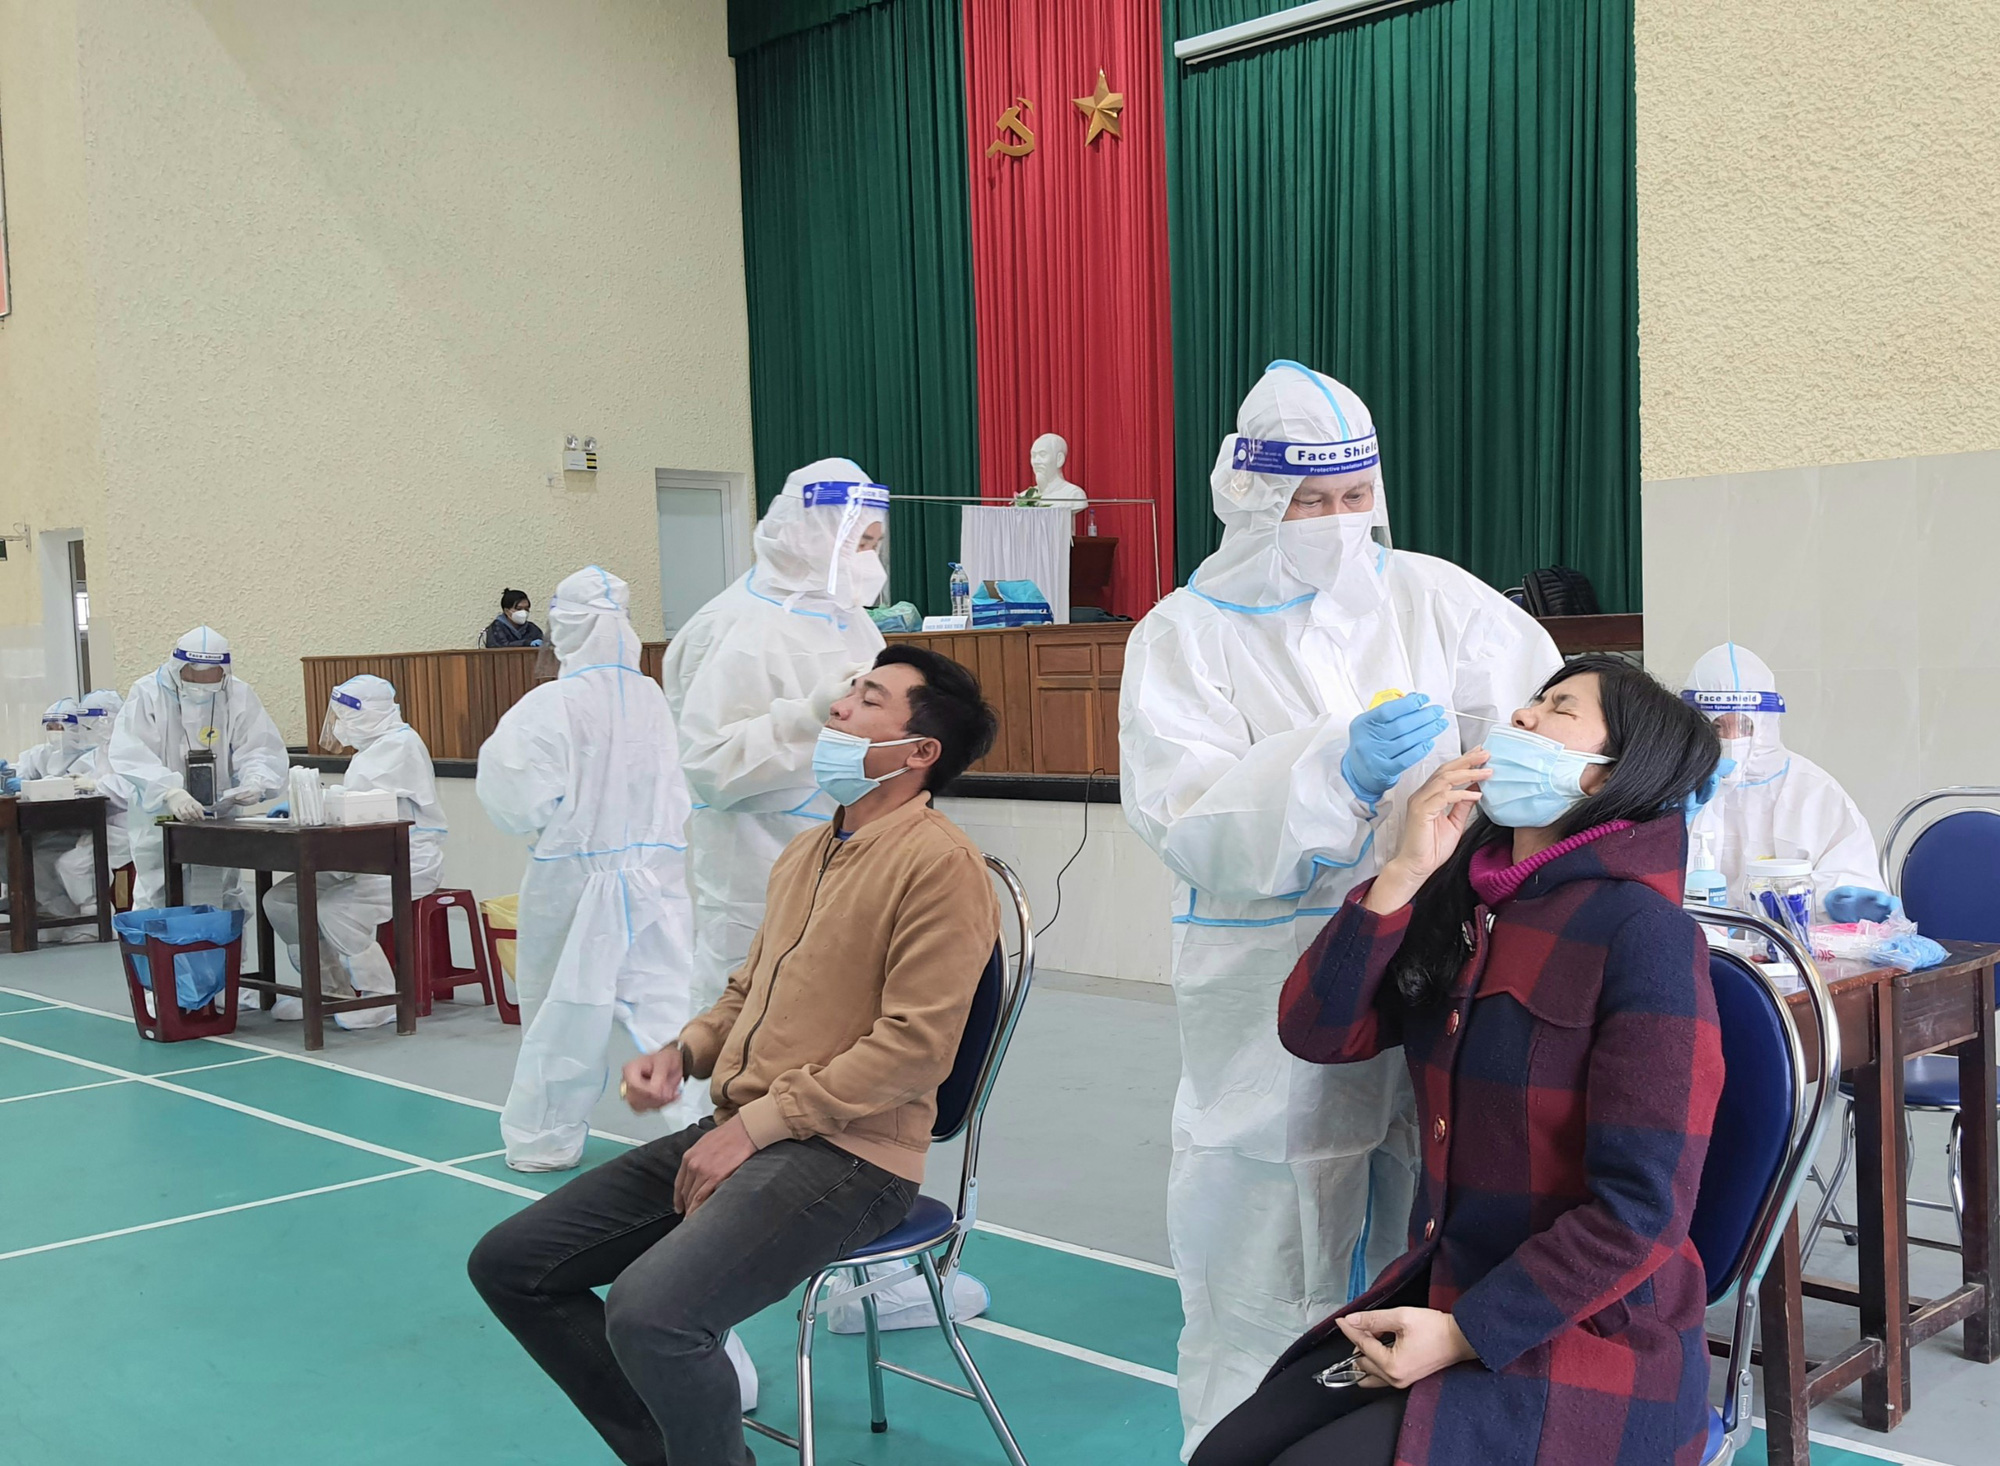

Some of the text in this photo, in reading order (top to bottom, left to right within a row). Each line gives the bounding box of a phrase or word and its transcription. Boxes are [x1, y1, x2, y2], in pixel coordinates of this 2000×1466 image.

[1298, 450, 1337, 461] Face
[1341, 462, 1362, 470] Isolation
[1699, 694, 1722, 702] Face
[1726, 694, 1757, 703] shield
